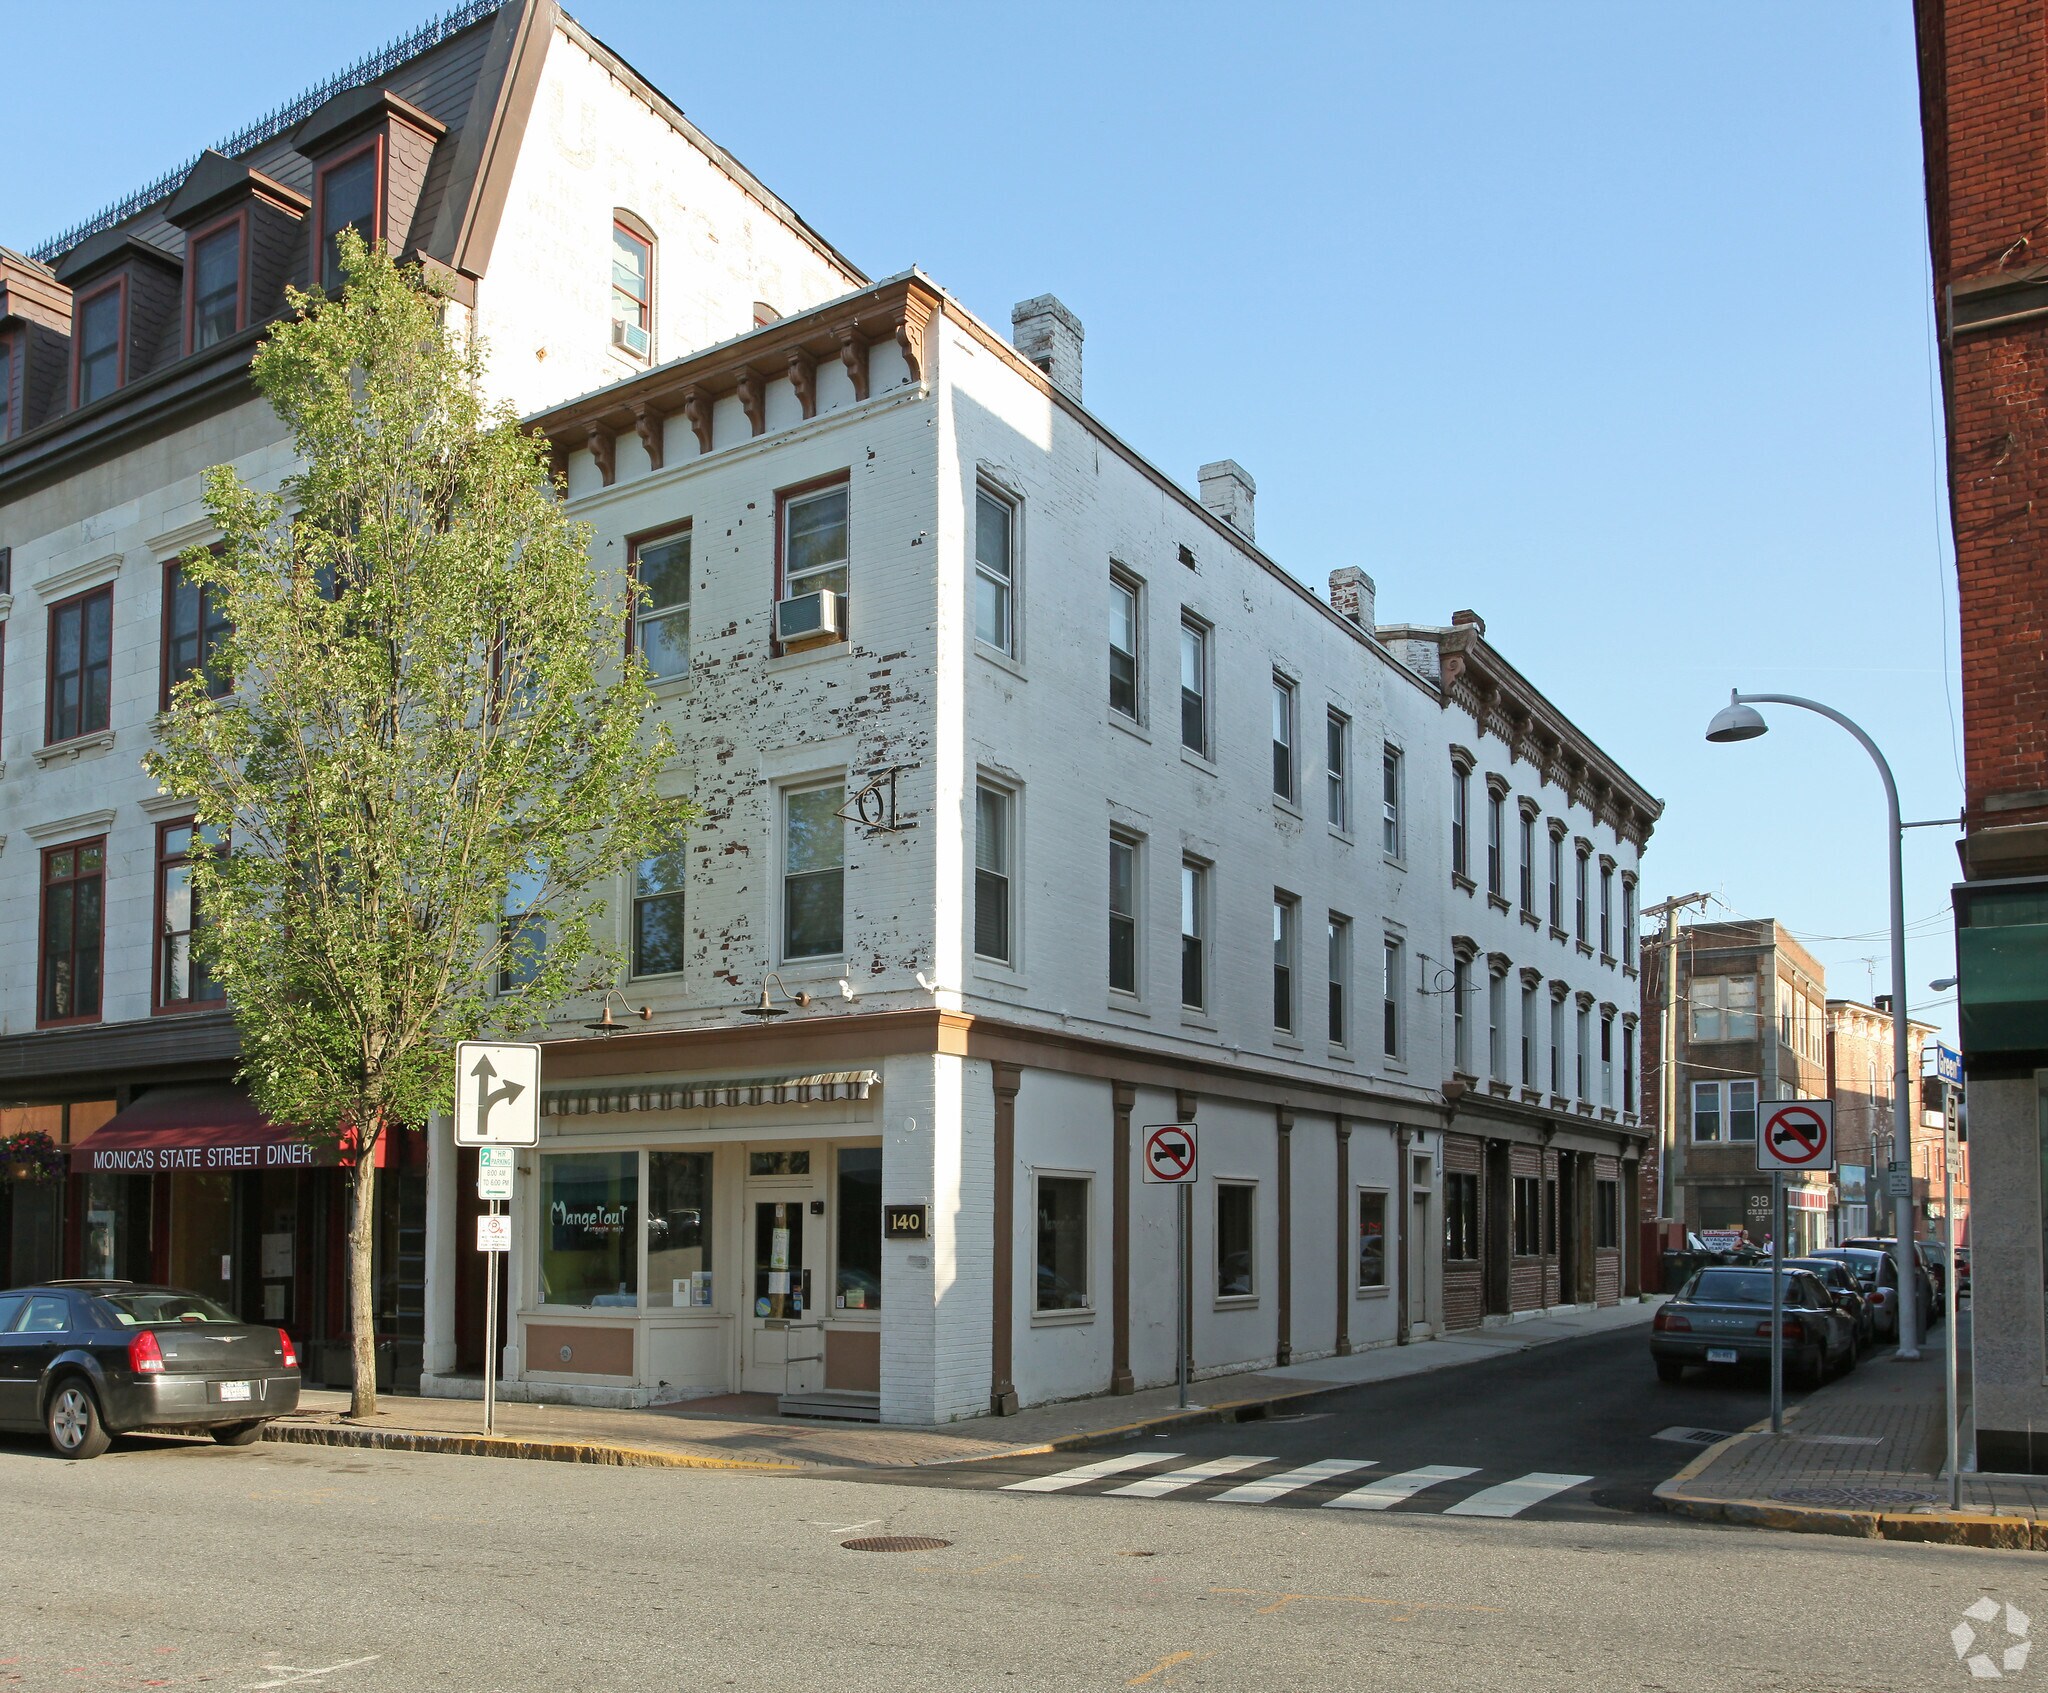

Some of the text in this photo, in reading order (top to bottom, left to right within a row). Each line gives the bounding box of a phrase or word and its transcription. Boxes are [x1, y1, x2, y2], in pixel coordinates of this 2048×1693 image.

[1938, 1047, 1957, 1079] Green
[94, 1144, 312, 1169] MONICA'S STATE STREET DINER
[481, 1151, 491, 1167] 2
[491, 1158, 511, 1166] PARKING
[1751, 1196, 1769, 1207] 38
[892, 1214, 920, 1230] 140
